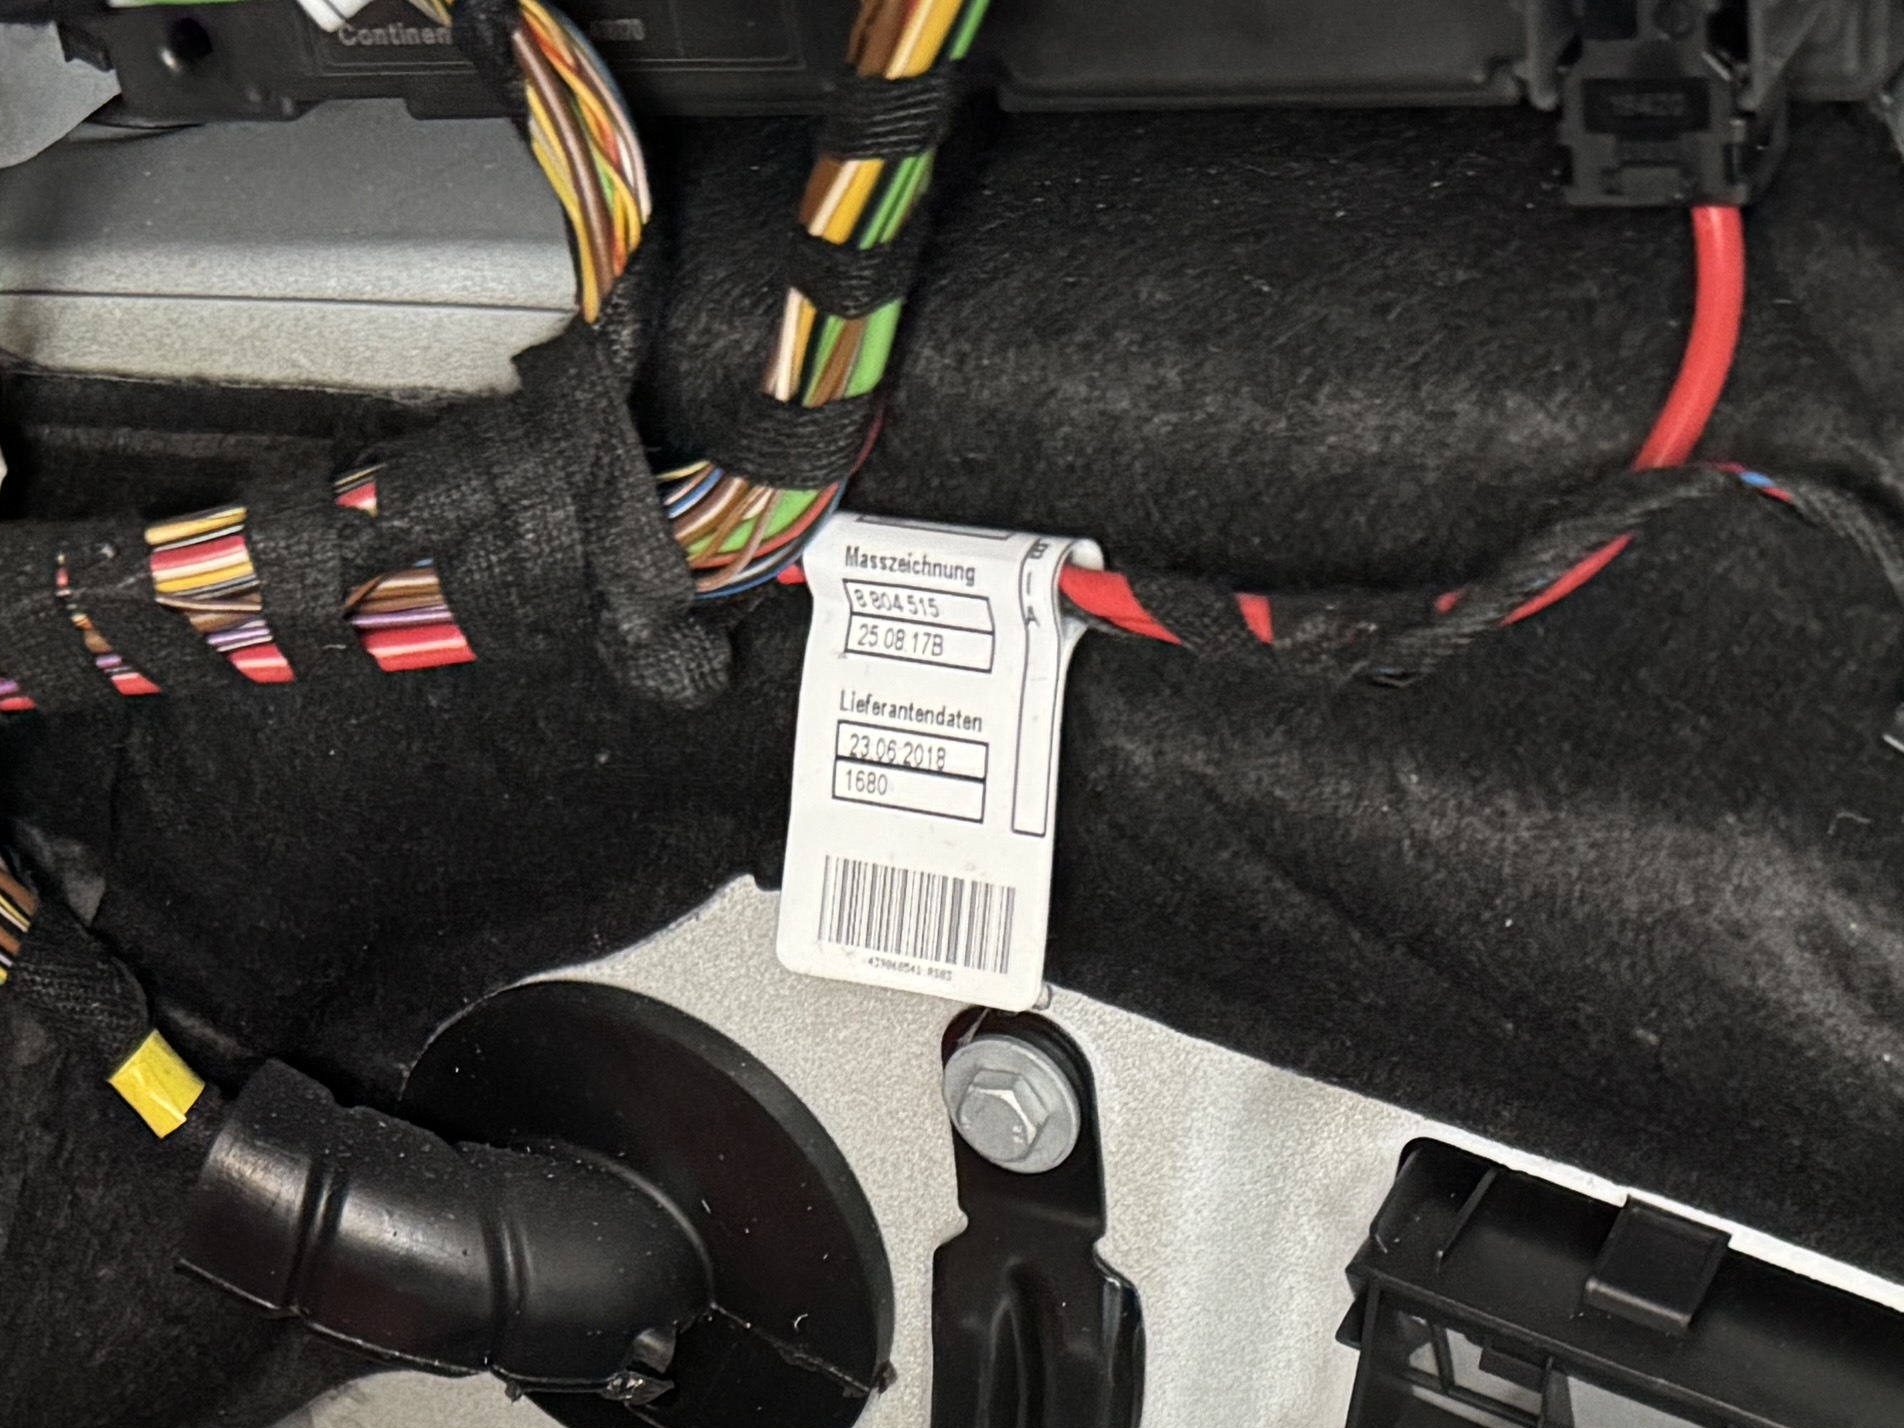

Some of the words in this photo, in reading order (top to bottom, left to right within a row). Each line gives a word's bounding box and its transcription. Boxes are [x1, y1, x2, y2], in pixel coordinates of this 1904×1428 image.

[845, 544, 975, 586] Masszeichnung
[839, 689, 983, 733] Lieferantendaten
[845, 768, 888, 796] 1680
